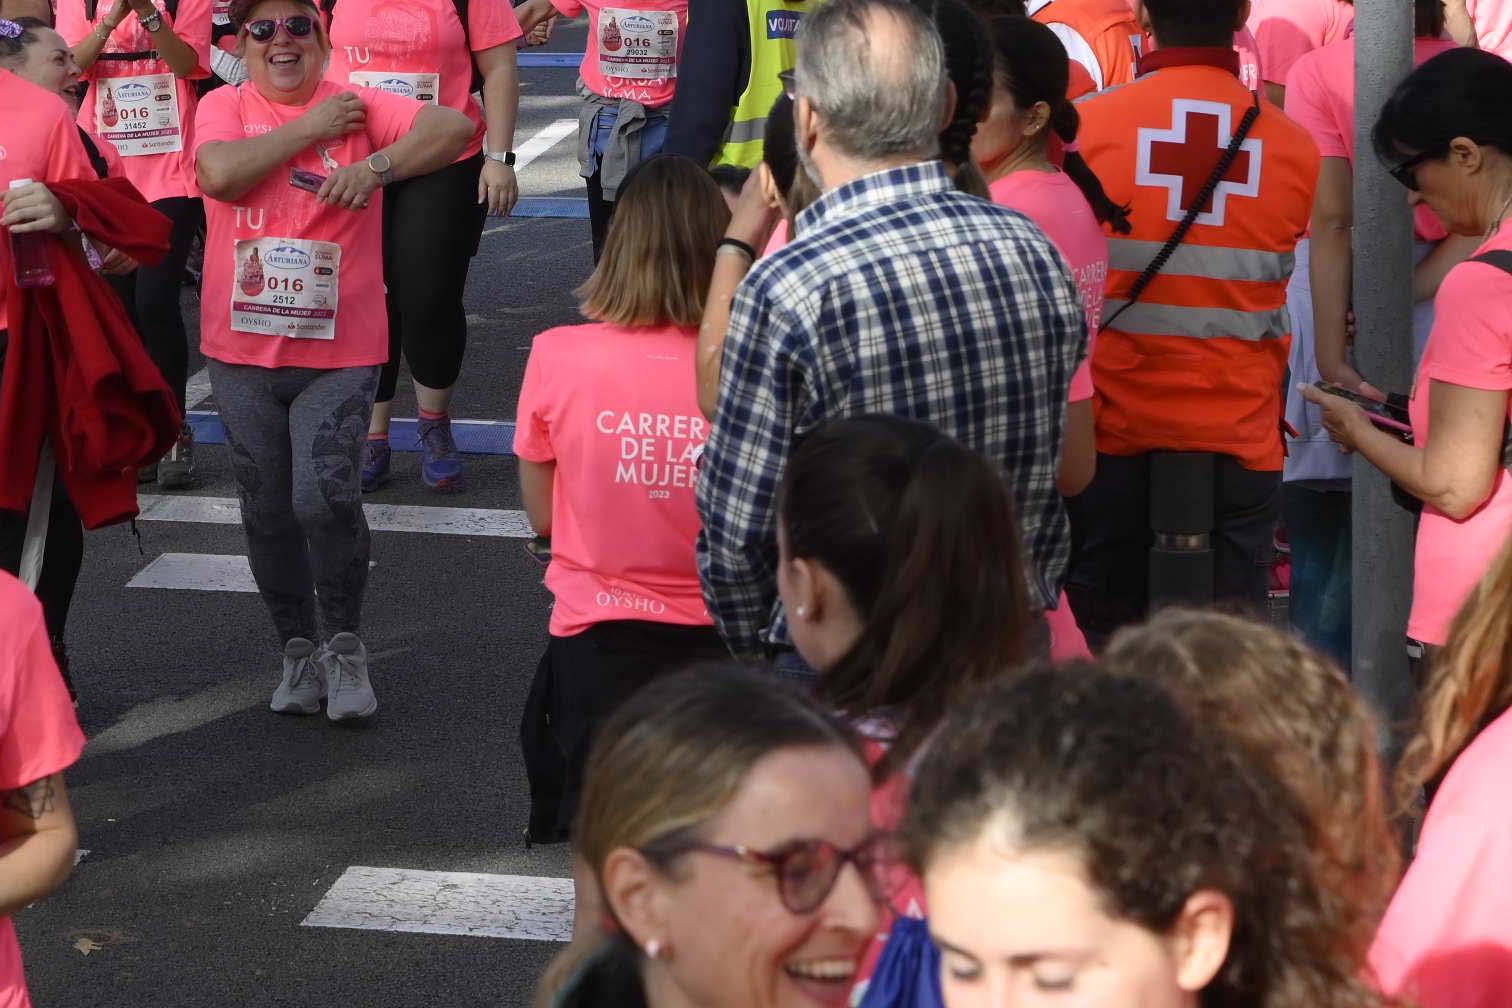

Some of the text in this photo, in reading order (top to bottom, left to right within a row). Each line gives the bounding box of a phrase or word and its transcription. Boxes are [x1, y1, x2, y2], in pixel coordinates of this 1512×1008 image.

[624, 37, 651, 47] 016
[344, 46, 370, 64] TU
[120, 107, 149, 120] 016
[233, 207, 264, 231] TU
[268, 276, 304, 292] 016
[273, 295, 296, 304] 2512
[241, 317, 271, 327] OYSHO
[621, 437, 656, 461] DE
[596, 591, 665, 615] OYSHO
